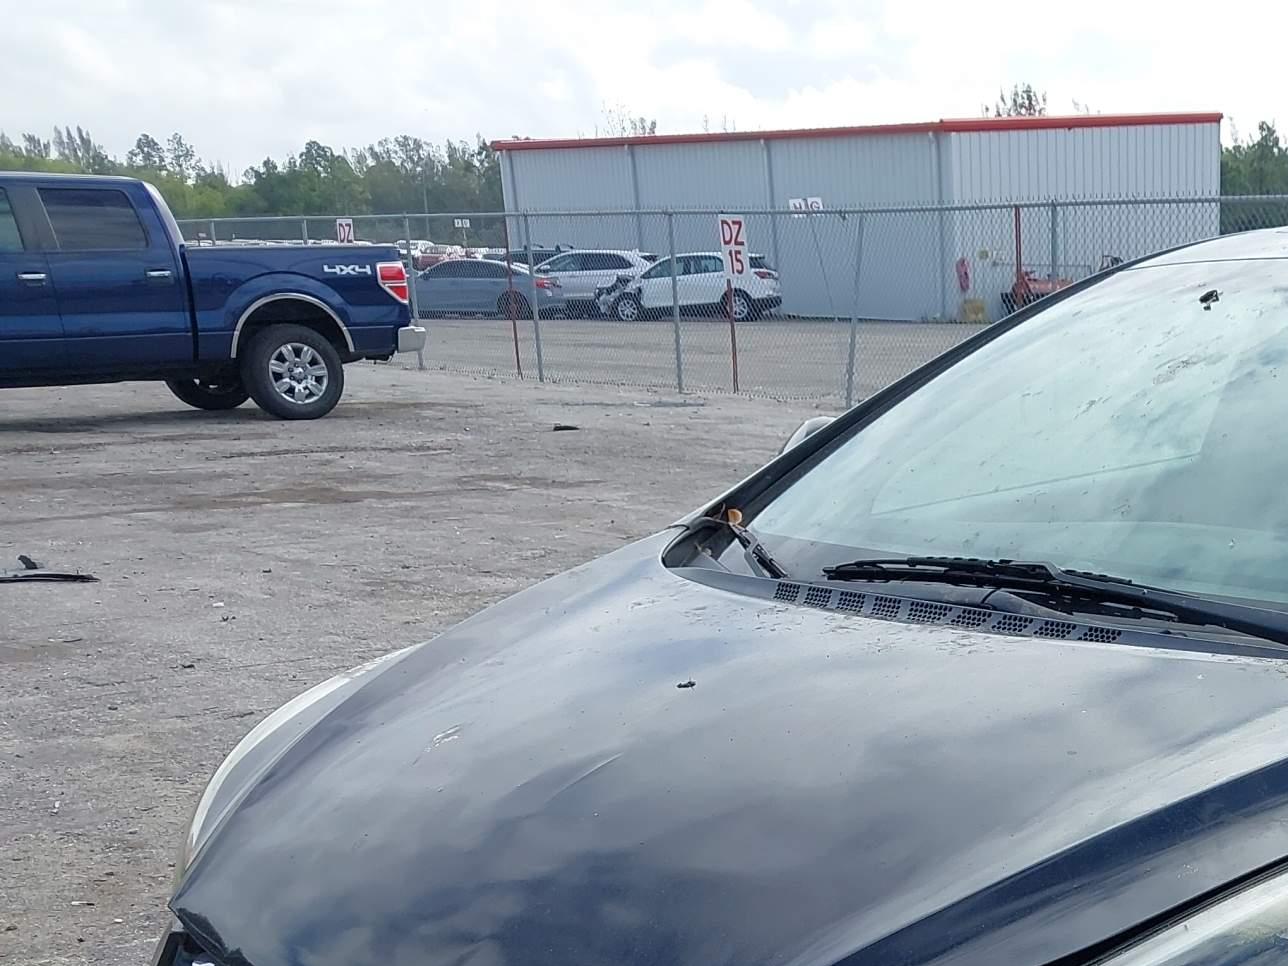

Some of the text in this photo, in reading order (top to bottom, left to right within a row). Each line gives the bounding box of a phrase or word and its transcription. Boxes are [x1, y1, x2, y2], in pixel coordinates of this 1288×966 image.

[337, 222, 353, 243] DZ
[720, 219, 745, 246] DZ
[728, 249, 745, 275] 15
